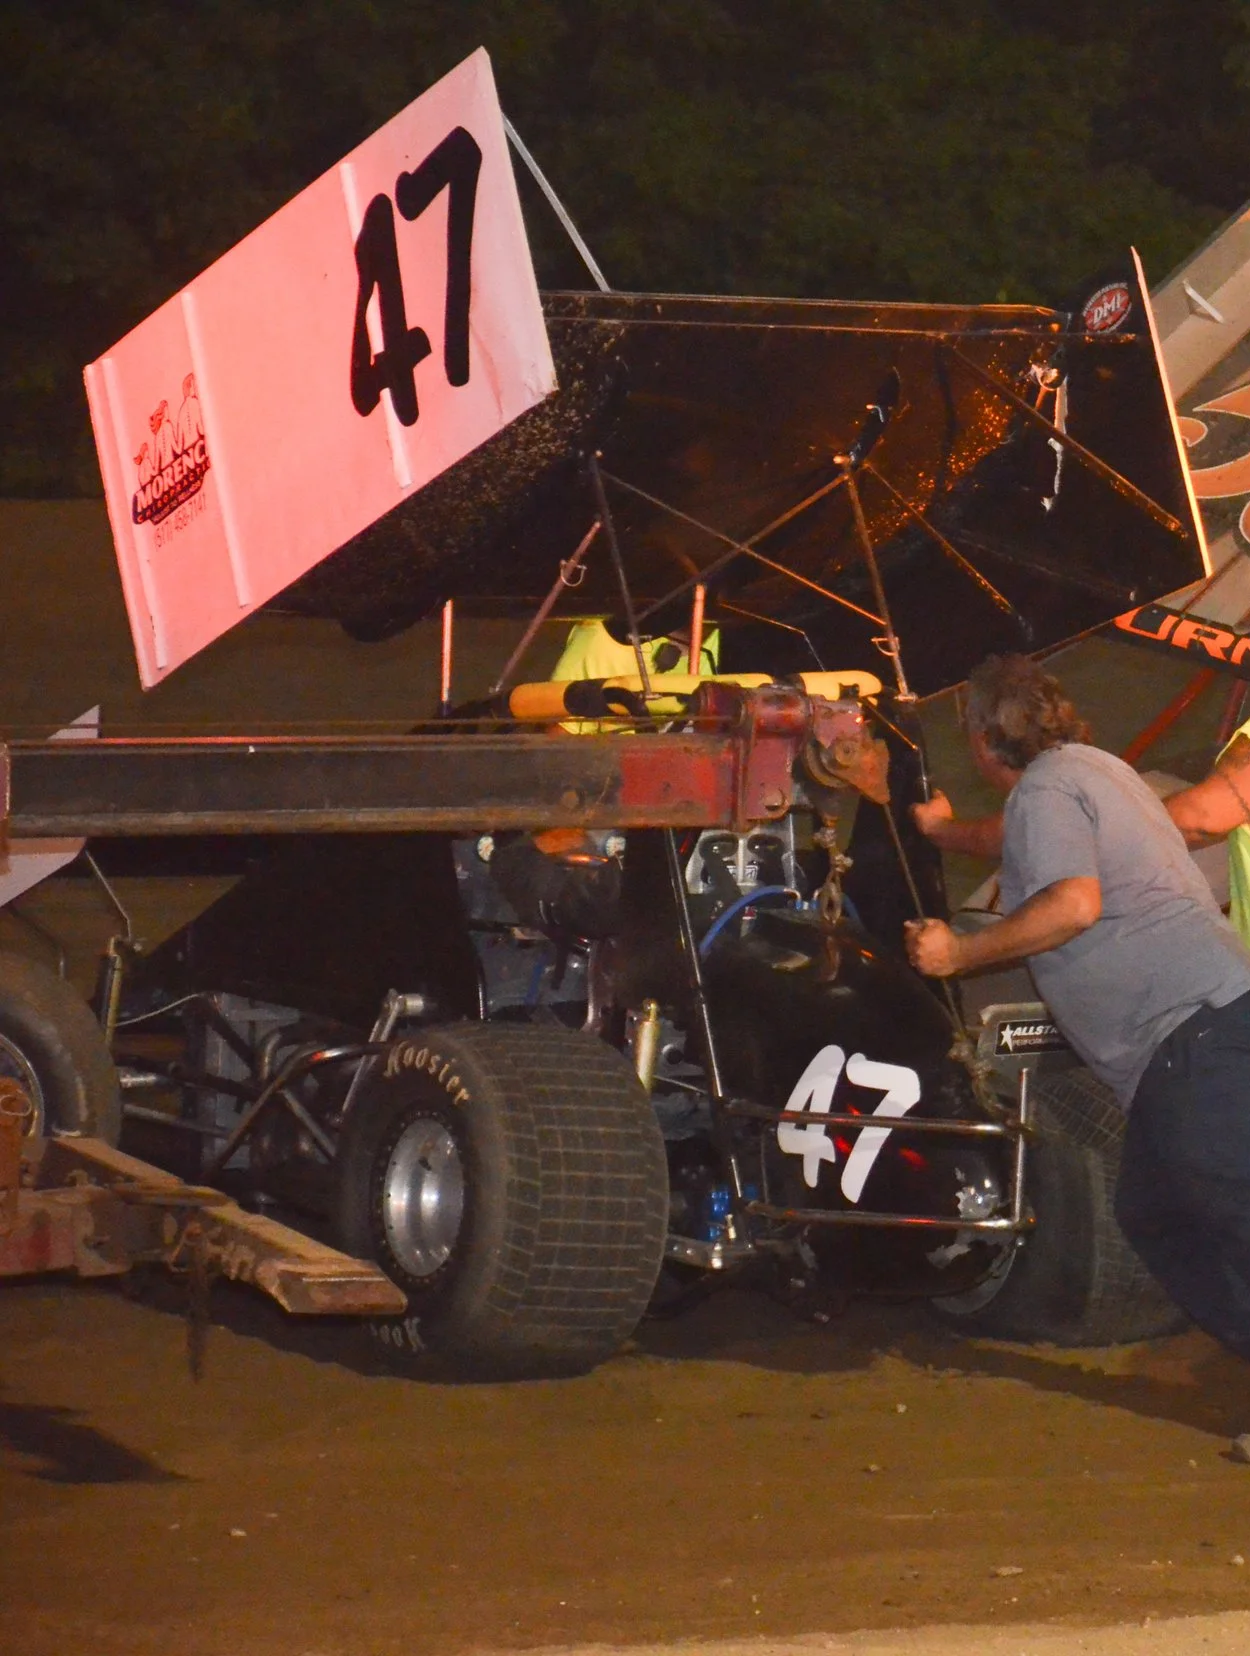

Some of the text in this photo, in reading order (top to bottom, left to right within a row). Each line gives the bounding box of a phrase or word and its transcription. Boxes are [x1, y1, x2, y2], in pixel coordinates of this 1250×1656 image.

[350, 126, 482, 426] 47
[1093, 293, 1121, 324] DMI
[135, 440, 207, 513] MORENC
[1013, 1025, 1058, 1036] ALLSTA
[383, 1040, 471, 1106] Hoosier
[777, 1044, 920, 1203] 47
